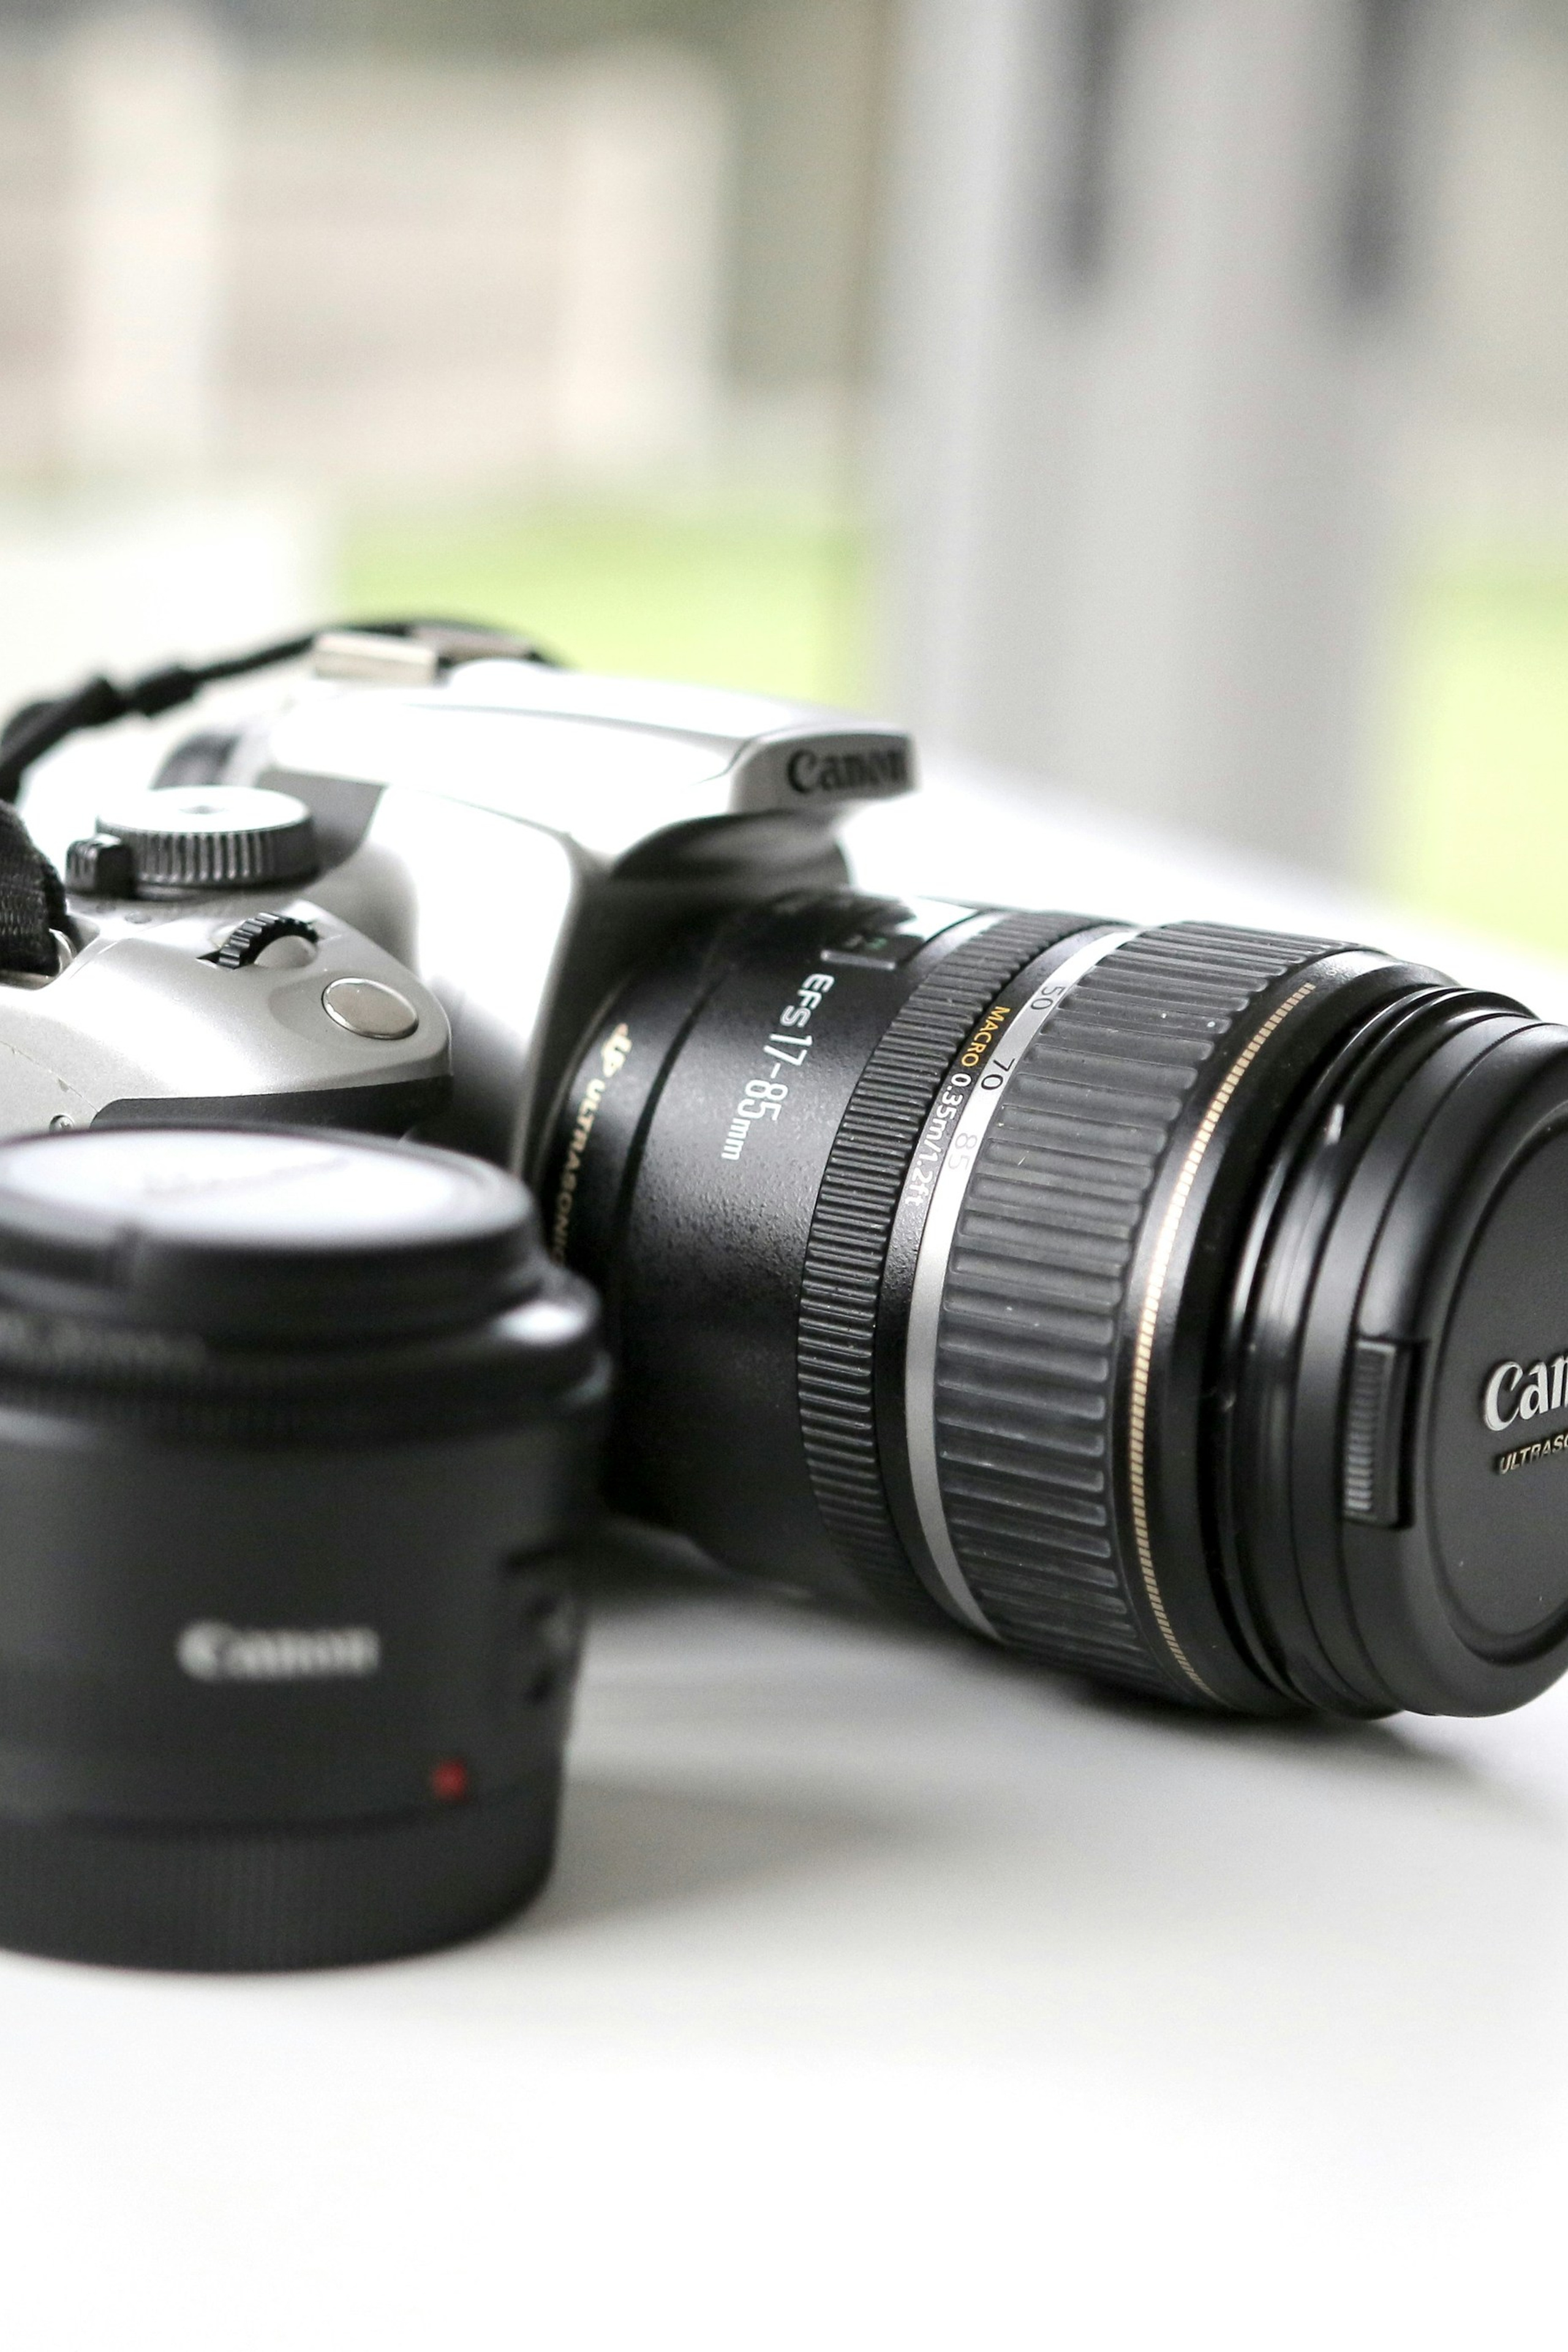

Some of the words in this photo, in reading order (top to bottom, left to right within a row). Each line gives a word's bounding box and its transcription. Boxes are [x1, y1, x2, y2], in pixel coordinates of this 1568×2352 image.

[786, 748, 908, 795] Canon
[1030, 986, 1063, 1010] 50
[961, 1006, 1011, 1068] MACRO
[981, 1058, 1016, 1090] 70
[904, 1072, 972, 1207] 0.35m/1.2ft
[948, 1133, 977, 1170] 85
[177, 1619, 380, 1683] Canon
